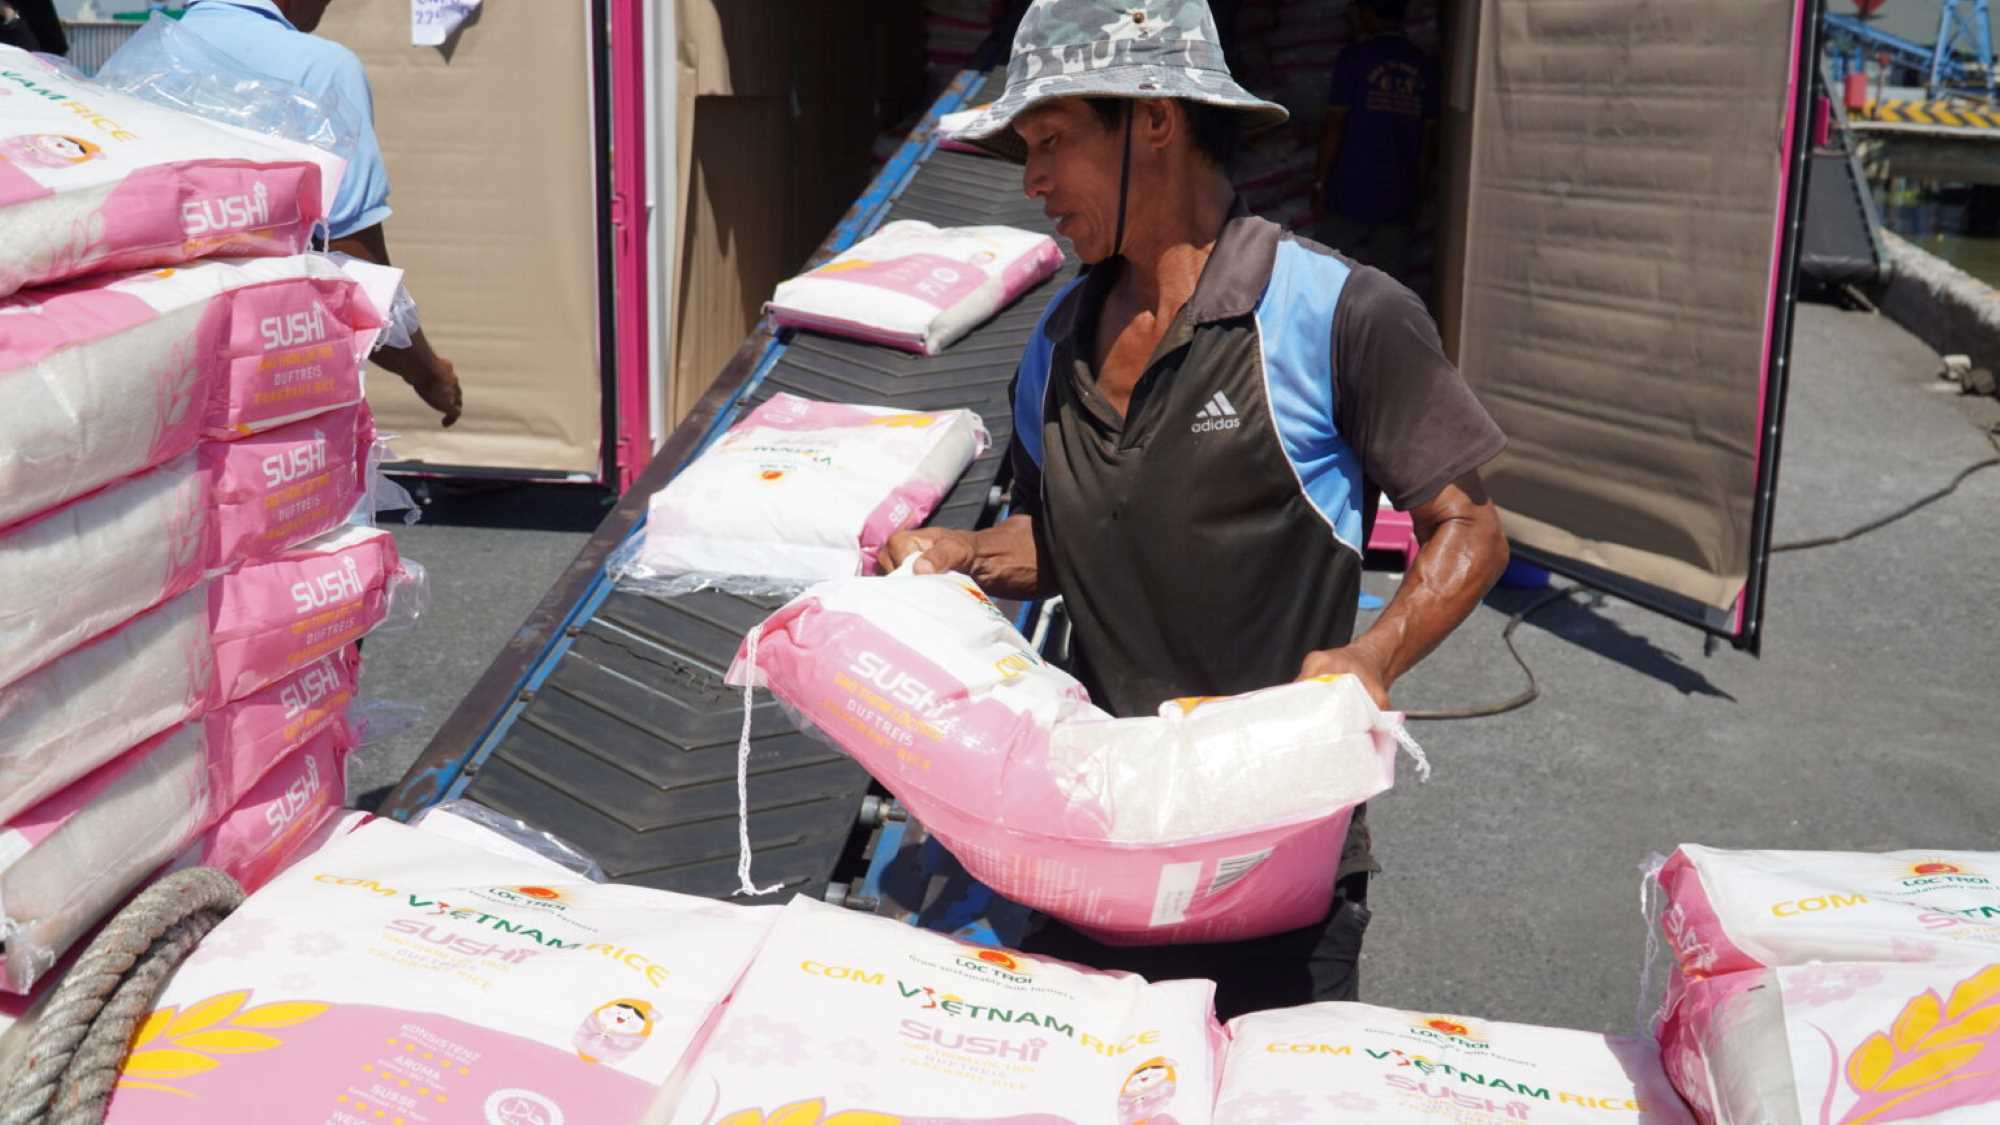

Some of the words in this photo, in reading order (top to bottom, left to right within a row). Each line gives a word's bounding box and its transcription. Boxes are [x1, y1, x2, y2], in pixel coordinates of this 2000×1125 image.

[1191, 417, 1241, 433] adidas
[847, 699, 914, 746] DUFTREIS
[1771, 893, 1868, 918] COM
[313, 873, 398, 897] COM
[585, 942, 671, 988] RICE
[800, 959, 886, 986] COM
[1080, 1029, 1162, 1057] RICE
[1266, 1042, 1352, 1057] COM
